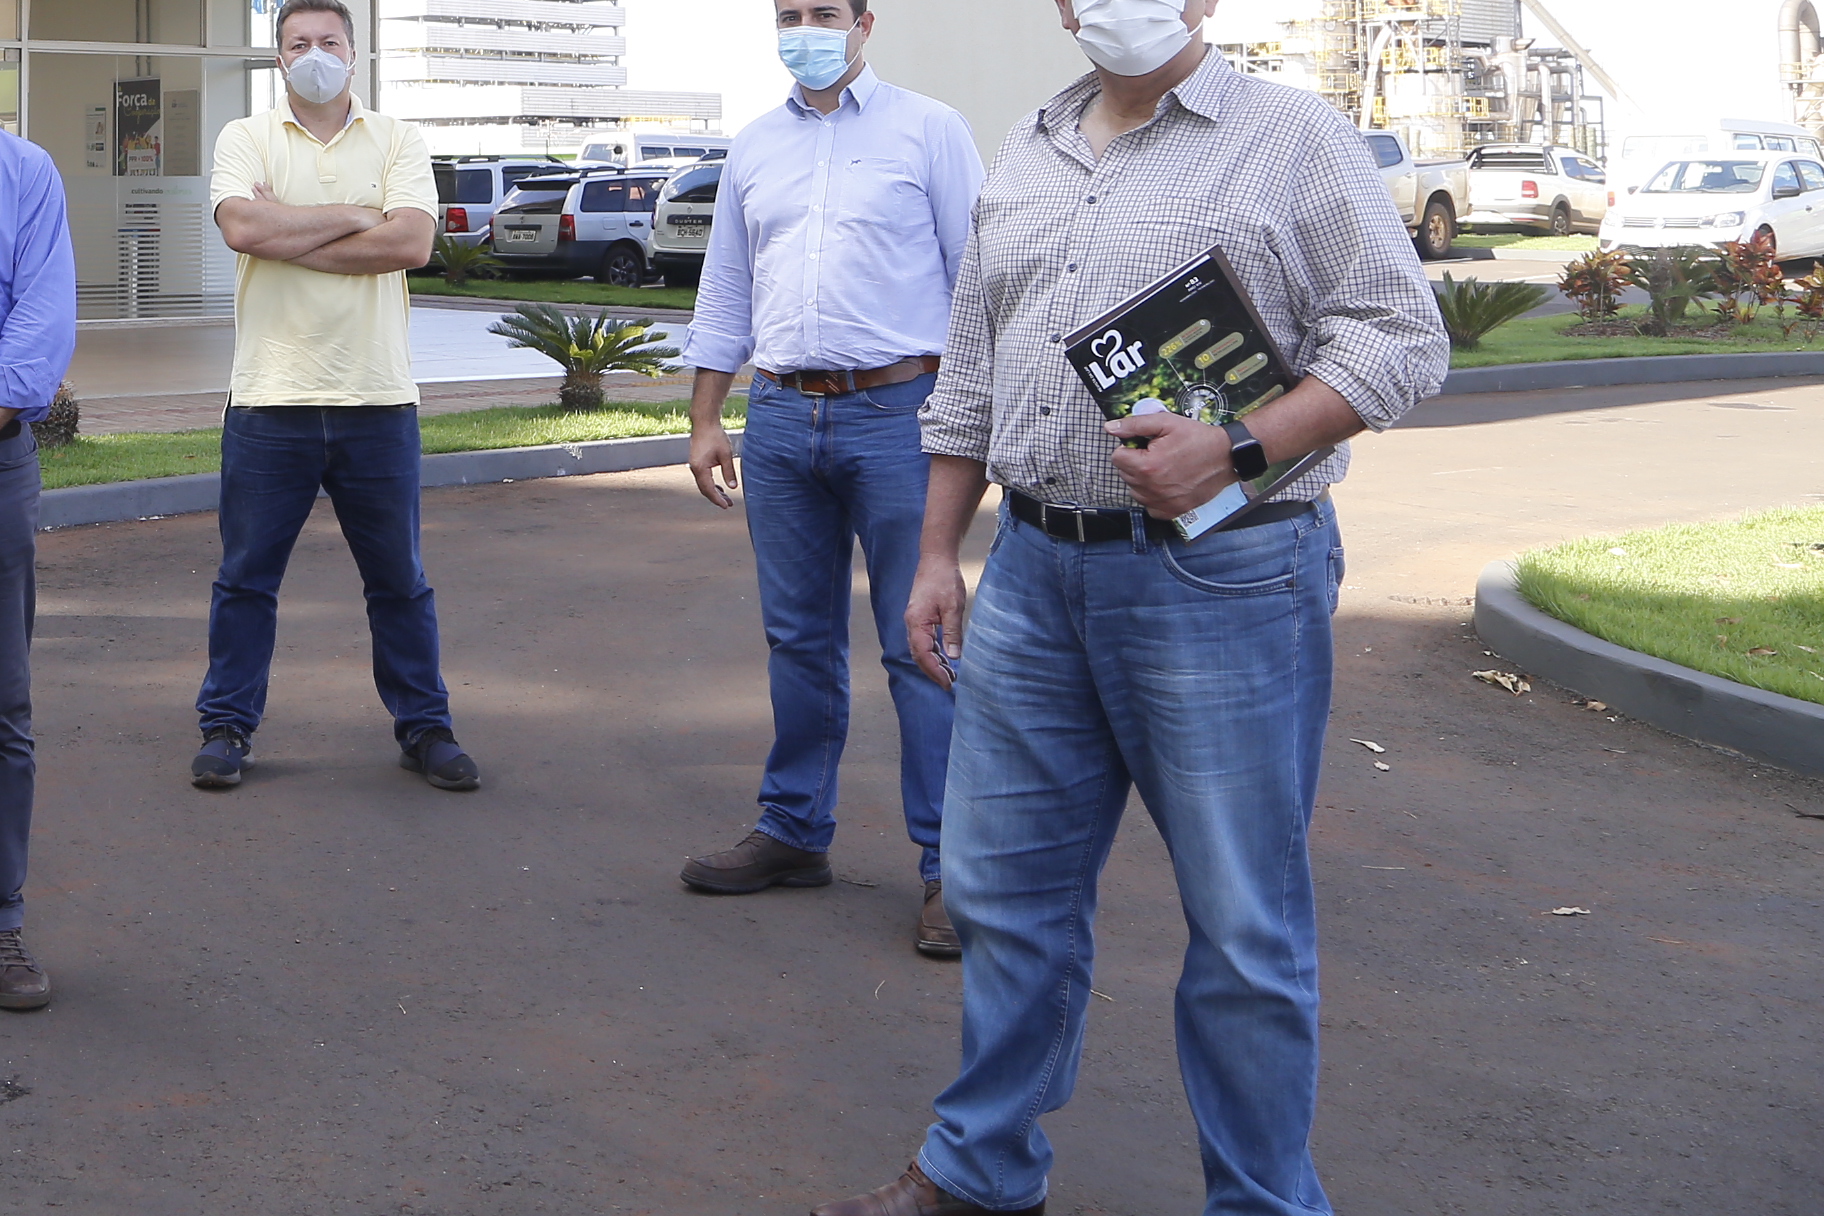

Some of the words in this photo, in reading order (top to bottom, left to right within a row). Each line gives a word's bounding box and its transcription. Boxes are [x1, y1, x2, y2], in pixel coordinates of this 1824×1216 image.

[116, 92, 148, 111] Força
[1161, 340, 1183, 356] 226%
[1088, 340, 1146, 390] Lar
[1198, 353, 1210, 364] 10
[1185, 400, 1207, 416] Força
